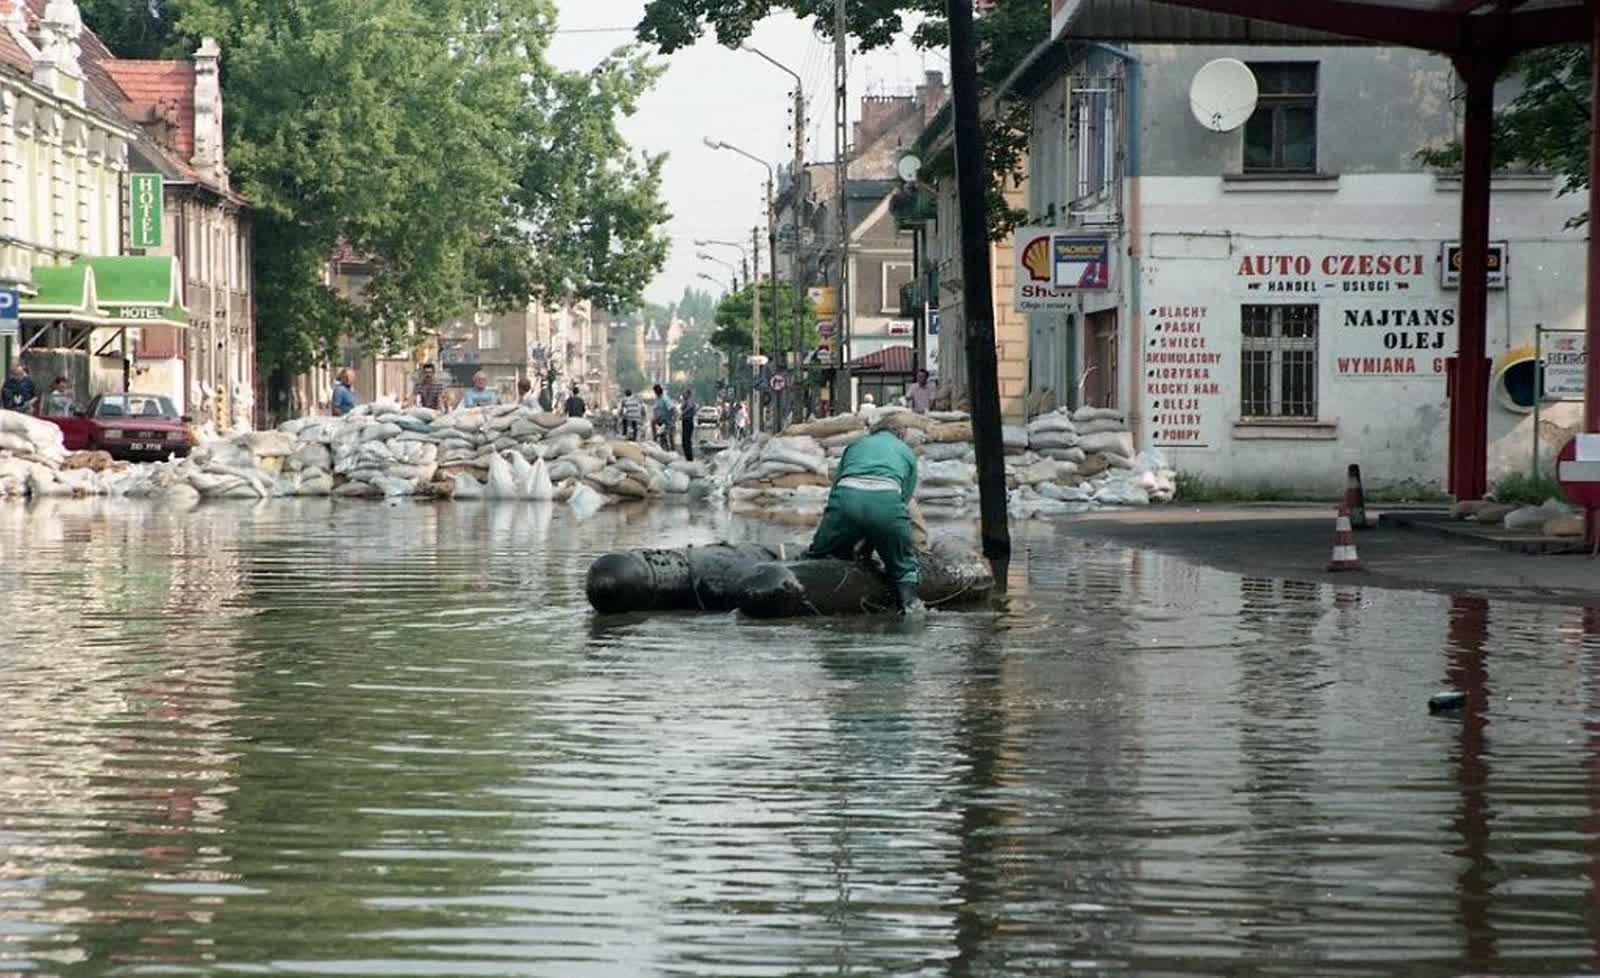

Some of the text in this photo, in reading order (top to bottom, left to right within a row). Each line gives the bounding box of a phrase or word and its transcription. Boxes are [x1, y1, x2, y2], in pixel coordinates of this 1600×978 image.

[139, 178, 153, 245] HOTEL
[1237, 254, 1312, 276] AUTO
[1267, 280, 1317, 293] HANDEL
[120, 308, 160, 318] HOTEL
[1158, 306, 1207, 318] BLACHY
[1344, 309, 1455, 327] NAJTANS
[1164, 321, 1201, 333] PASKI
[1384, 332, 1446, 349] OLEJ
[1146, 352, 1221, 364] AKUMULATORY
[1338, 357, 1415, 373] WYMIANA
[1163, 399, 1199, 410] OLEJE
[1161, 414, 1202, 425] FILTRY
[1163, 429, 1200, 440] POMPY
